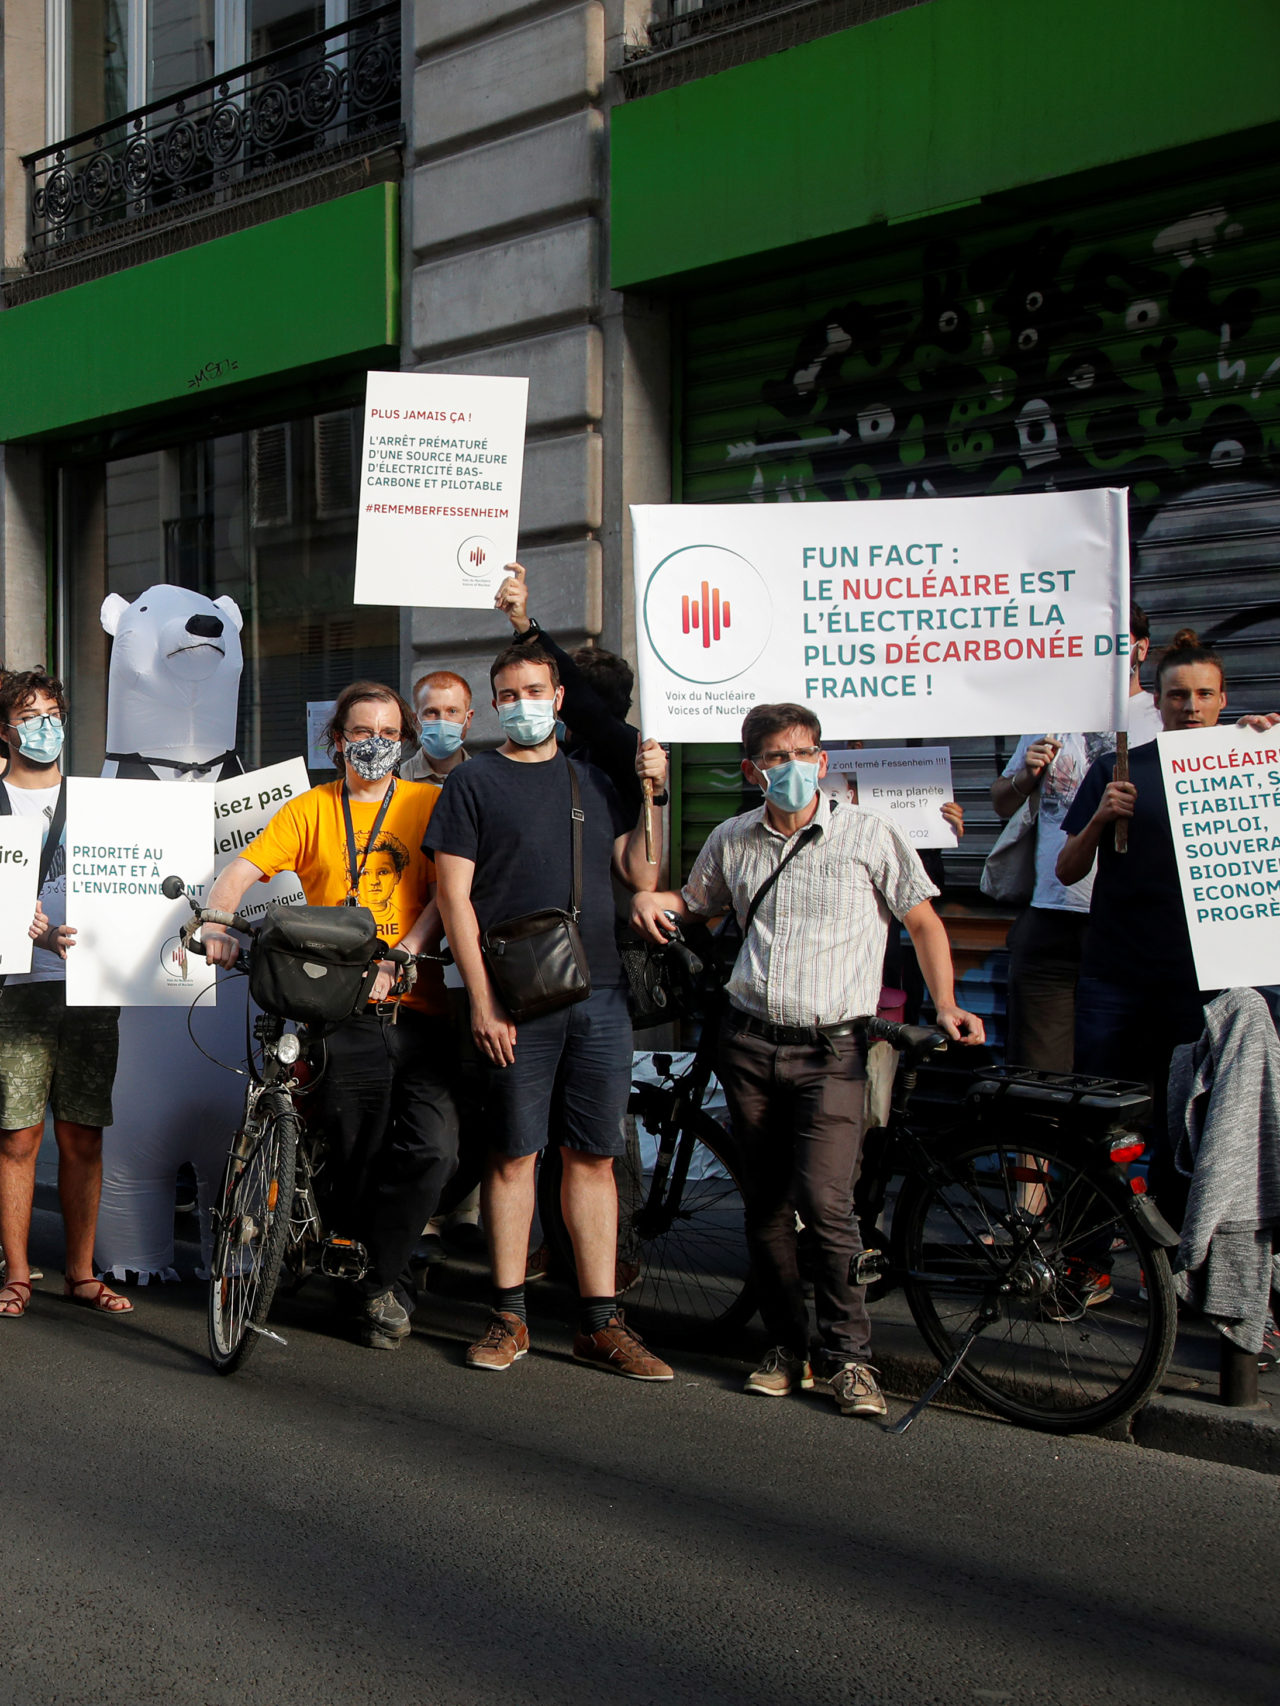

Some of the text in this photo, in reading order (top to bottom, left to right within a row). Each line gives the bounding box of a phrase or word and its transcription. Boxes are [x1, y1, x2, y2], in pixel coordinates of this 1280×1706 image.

[371, 409, 472, 424] PLUS JAMAIS ÇA !
[369, 434, 488, 450] L'ARRÊT PRÉMATURÉ
[368, 449, 508, 464] D'UNE SOURCE MAJEURE
[368, 461, 483, 477] D'ÉLECTRICITÉ BAS-
[367, 477, 503, 491] CARBONE ET PILOTABLE
[365, 504, 509, 518] #REMEMBERFESSENHEIM
[803, 543, 959, 569] FUN FACT :
[803, 569, 1076, 601] LE NUCLÉAIRE EST
[804, 598, 1065, 634] L’ÉLECTRICITÉ LA
[804, 629, 1129, 666] PLUS DÉCARBONÉE DE
[805, 674, 932, 699] FRANCE !
[665, 690, 756, 701] Voix du Nucléaire
[667, 705, 700, 715] Voices
[703, 705, 713, 715] of
[832, 761, 853, 769] z'ont
[855, 760, 880, 769] fermé
[882, 758, 934, 768] Fessenheim
[1171, 749, 1280, 774] NUCLÉAIR
[1175, 773, 1262, 795] CLIMAT,
[872, 787, 944, 798] Et ma planète
[214, 784, 293, 819] isez pas
[890, 799, 928, 809] alors !?
[1179, 787, 1280, 816] FIABILITÉ
[909, 830, 929, 838] CO2
[1182, 816, 1269, 838] EMPLOI,
[72, 844, 163, 860] PRIORITÉ AU
[1185, 836, 1280, 859] SOUVERA
[72, 862, 160, 878] CLIMAT ET À
[1189, 857, 1280, 881] BIODIVE
[73, 881, 205, 896] L’ENVIRONNENT
[1193, 880, 1280, 902] ECONOM
[1197, 898, 1280, 924] PROGRÈ
[376, 923, 399, 936] RIE
